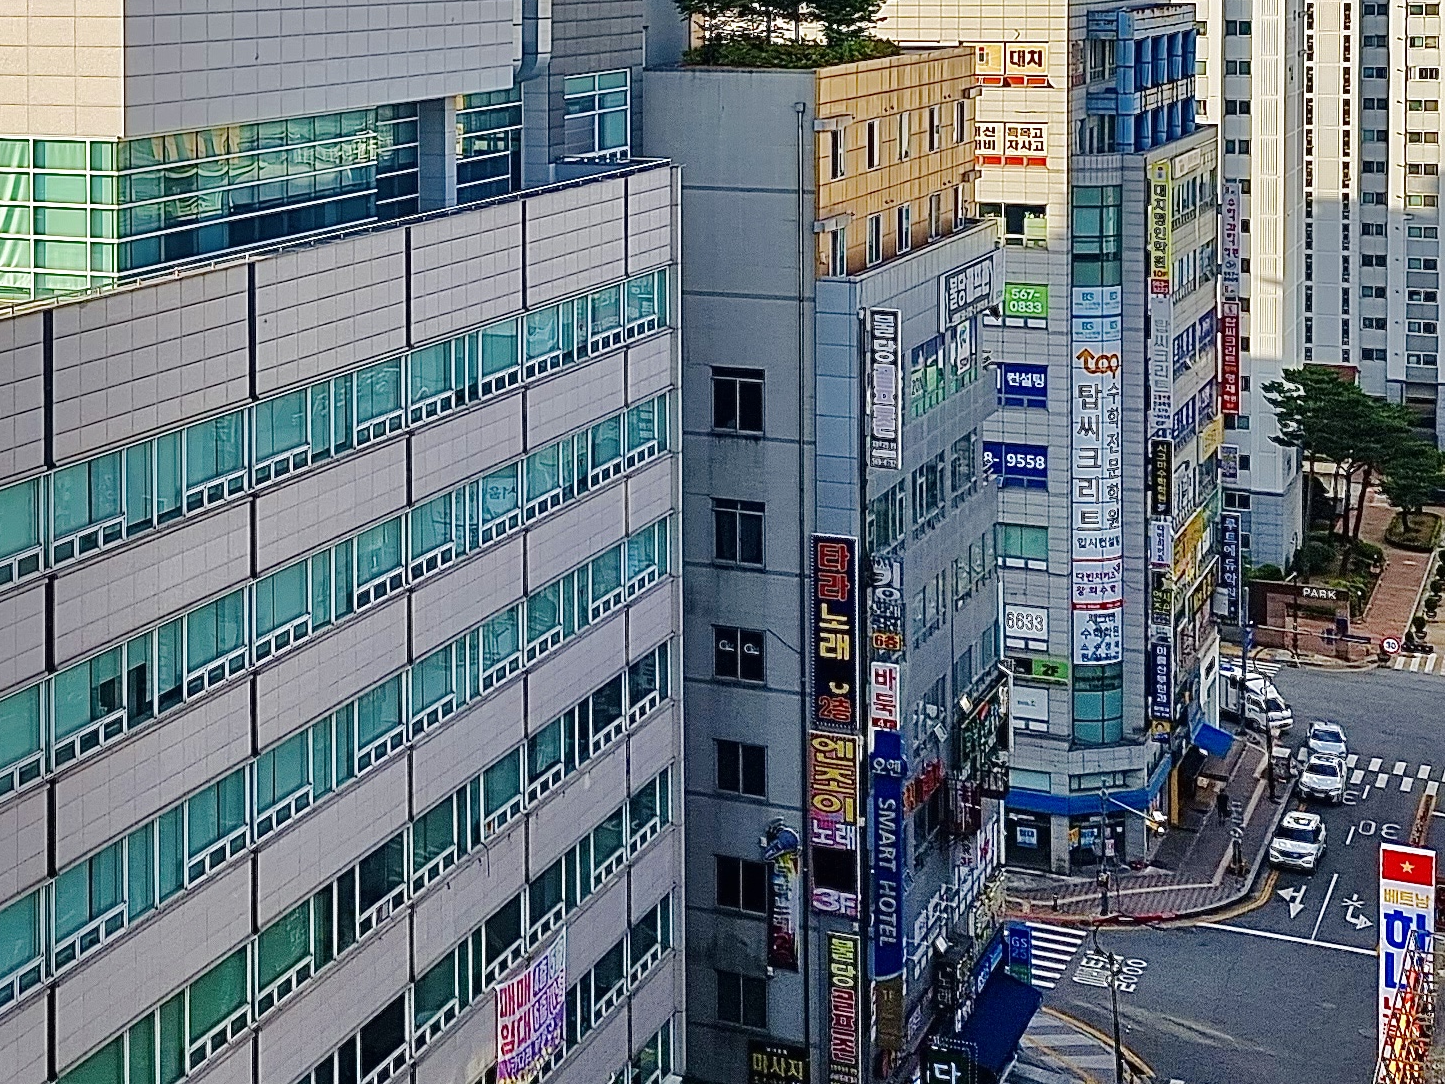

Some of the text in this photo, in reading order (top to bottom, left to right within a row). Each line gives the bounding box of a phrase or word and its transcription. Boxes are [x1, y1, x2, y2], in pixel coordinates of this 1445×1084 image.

[1010, 49, 1043, 68] 대치
[1007, 139, 1045, 152] 자사고
[1009, 300, 1042, 314] 0833
[1007, 372, 1045, 388] 컨설팅
[1006, 454, 1045, 469] 9558
[1077, 383, 1103, 532] 탑씨크리트
[1107, 382, 1120, 530] 수학전문학원
[1303, 587, 1337, 600] PARK
[1006, 612, 1044, 632] 6633
[874, 667, 897, 717] 바둑
[819, 695, 852, 723] 2층
[812, 820, 856, 851] 노래
[877, 797, 897, 947] SMART HOTEL
[812, 887, 857, 914] 3F
[1383, 888, 1430, 910] 베트남
[1011, 936, 1028, 948] GS
[500, 970, 532, 1018] 매매
[501, 1009, 532, 1057] 임대
[752, 1052, 804, 1081] 마사지
